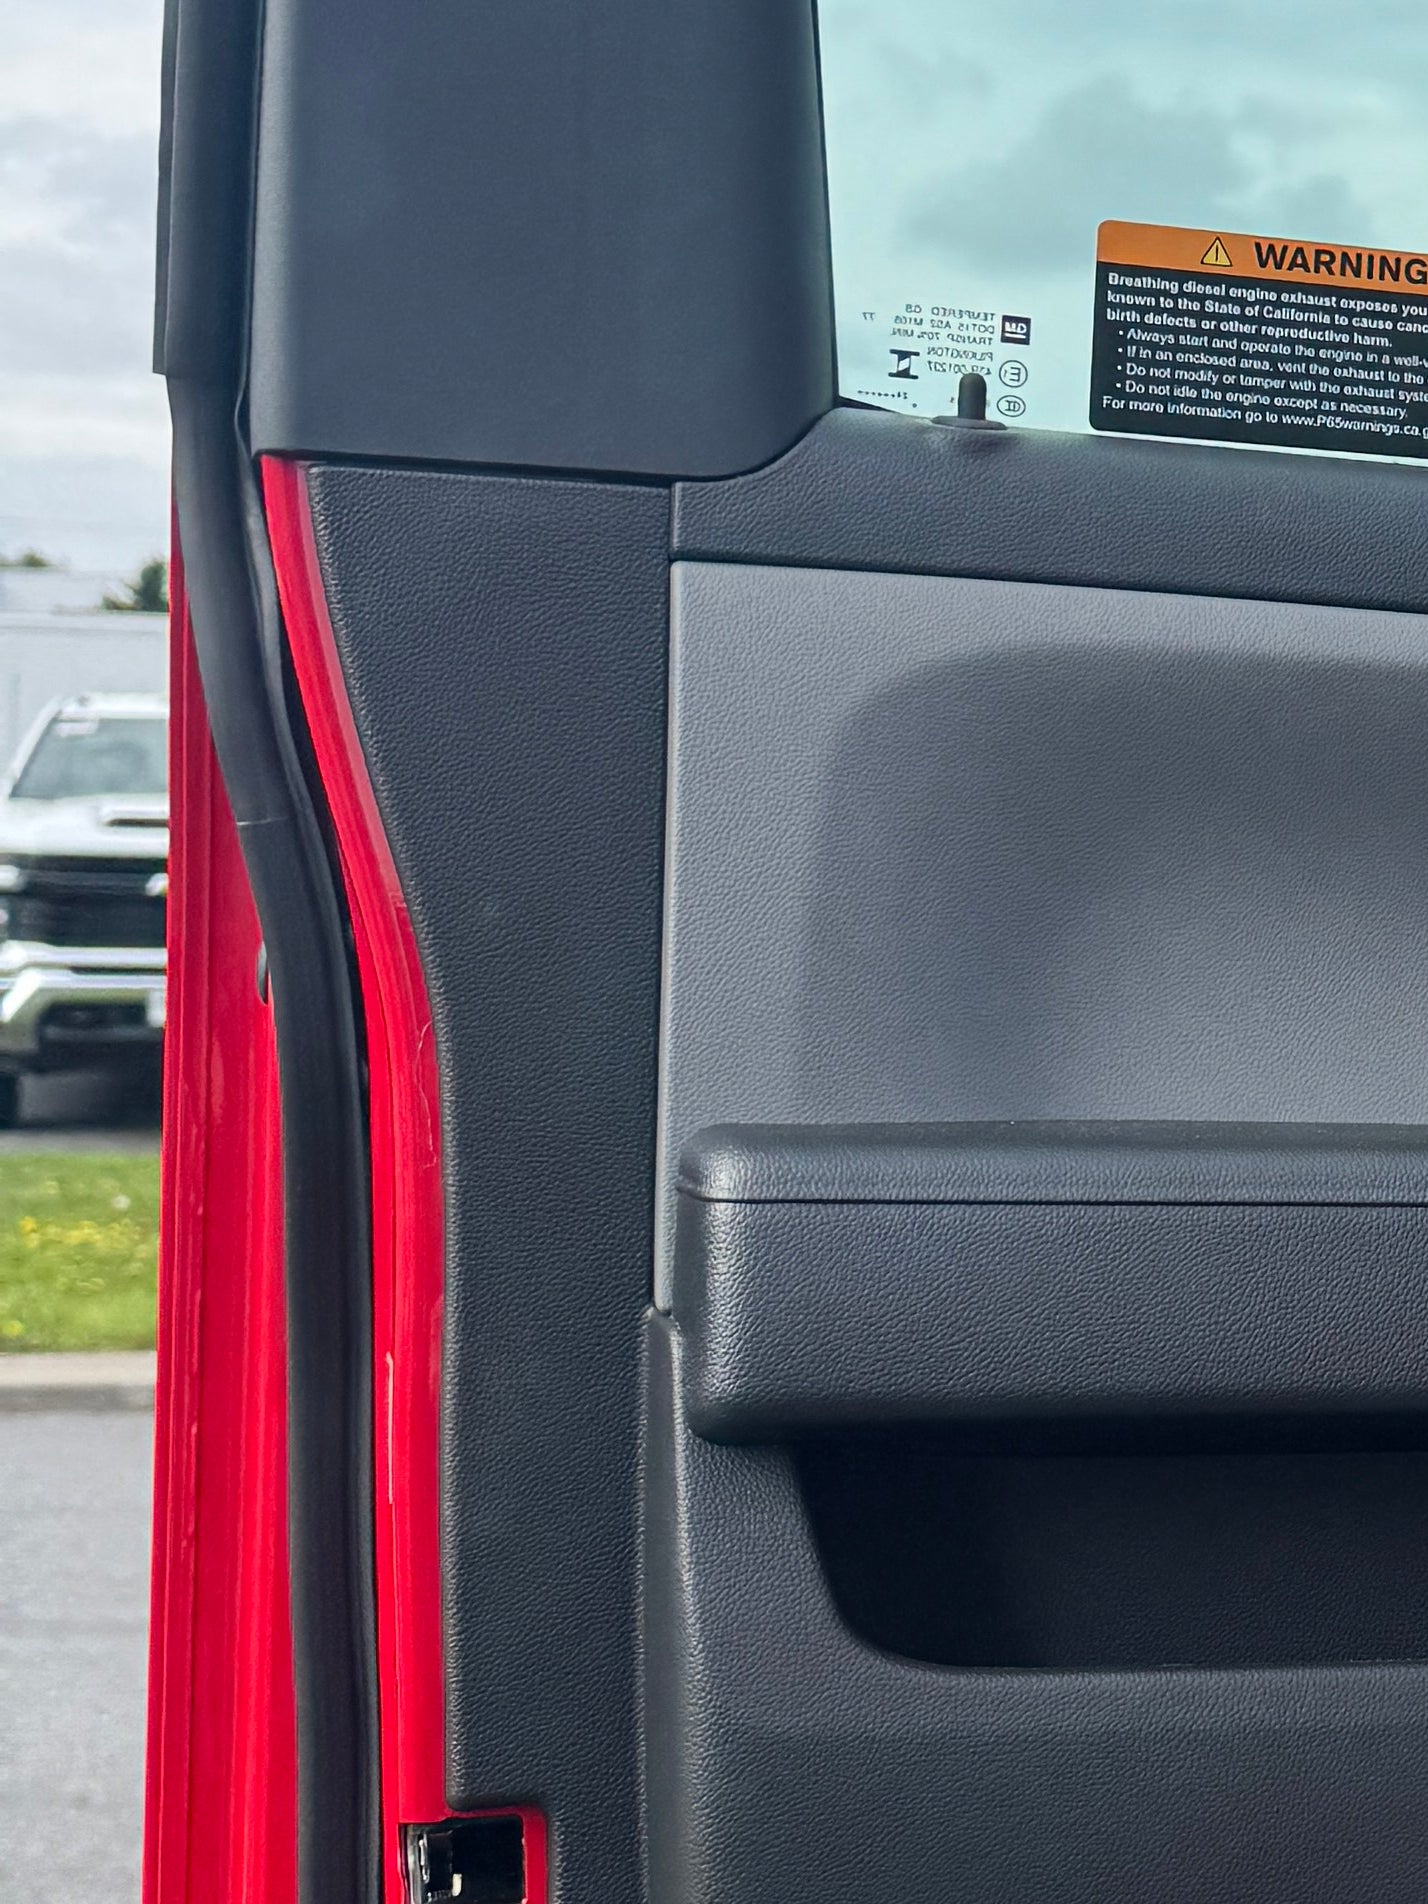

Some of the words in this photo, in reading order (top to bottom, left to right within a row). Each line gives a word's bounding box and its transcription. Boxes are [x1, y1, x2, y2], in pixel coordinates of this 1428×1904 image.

[1254, 242, 1428, 285] WARNING
[1108, 272, 1179, 294] Breathing
[1183, 280, 1226, 296] diesel
[1230, 286, 1277, 302] engine
[1280, 291, 1336, 308] exhaust
[1340, 298, 1398, 314] exposes
[1402, 304, 1428, 318] you
[1108, 290, 1156, 307] known
[1160, 297, 1174, 309] to
[1178, 298, 1200, 312] the
[1204, 300, 1241, 316] State
[1244, 304, 1260, 317] of
[1263, 306, 1330, 324] California
[1334, 314, 1349, 326] to
[1352, 316, 1394, 331] cause
[1106, 308, 1140, 324] birth
[1144, 312, 1196, 329] defects
[1201, 320, 1218, 331] or
[1220, 320, 1258, 334] other
[1260, 324, 1350, 344] reproductive
[1353, 332, 1393, 348] harm.
[1126, 328, 1175, 346] Always
[1178, 334, 1208, 348] start
[1212, 336, 1238, 350] and
[1240, 340, 1292, 355] operate
[1294, 344, 1316, 357] the
[1318, 348, 1362, 363] engine
[1366, 351, 1378, 364] in
[1382, 354, 1390, 364] a
[1126, 346, 1138, 358] If
[1140, 347, 1152, 360] in
[1156, 350, 1174, 362] an
[1176, 352, 1236, 368] enclosed
[1278, 362, 1306, 374] vent
[1309, 364, 1330, 376] the
[1334, 366, 1385, 382] exhaust
[1388, 370, 1400, 382] to
[1404, 371, 1425, 385] the
[1126, 362, 1146, 376] Do
[1150, 366, 1172, 378] not
[1174, 368, 1219, 386] modify
[1222, 374, 1236, 385] or
[1240, 374, 1286, 392] tamper
[1289, 378, 1316, 392] with
[1319, 381, 1340, 394] the
[1344, 384, 1395, 400] exhaust
[1102, 396, 1125, 410] For
[1129, 401, 1164, 414] more
[1167, 402, 1241, 420] information
[1245, 410, 1262, 424] go
[1266, 410, 1279, 424] to
[1126, 380, 1146, 394] Do
[1148, 382, 1170, 396] not
[1174, 384, 1198, 398] idle
[1201, 388, 1222, 401] the
[1226, 390, 1270, 406] engine
[1274, 396, 1318, 410] except
[1321, 402, 1337, 412] as
[1340, 402, 1408, 420] necessary.
